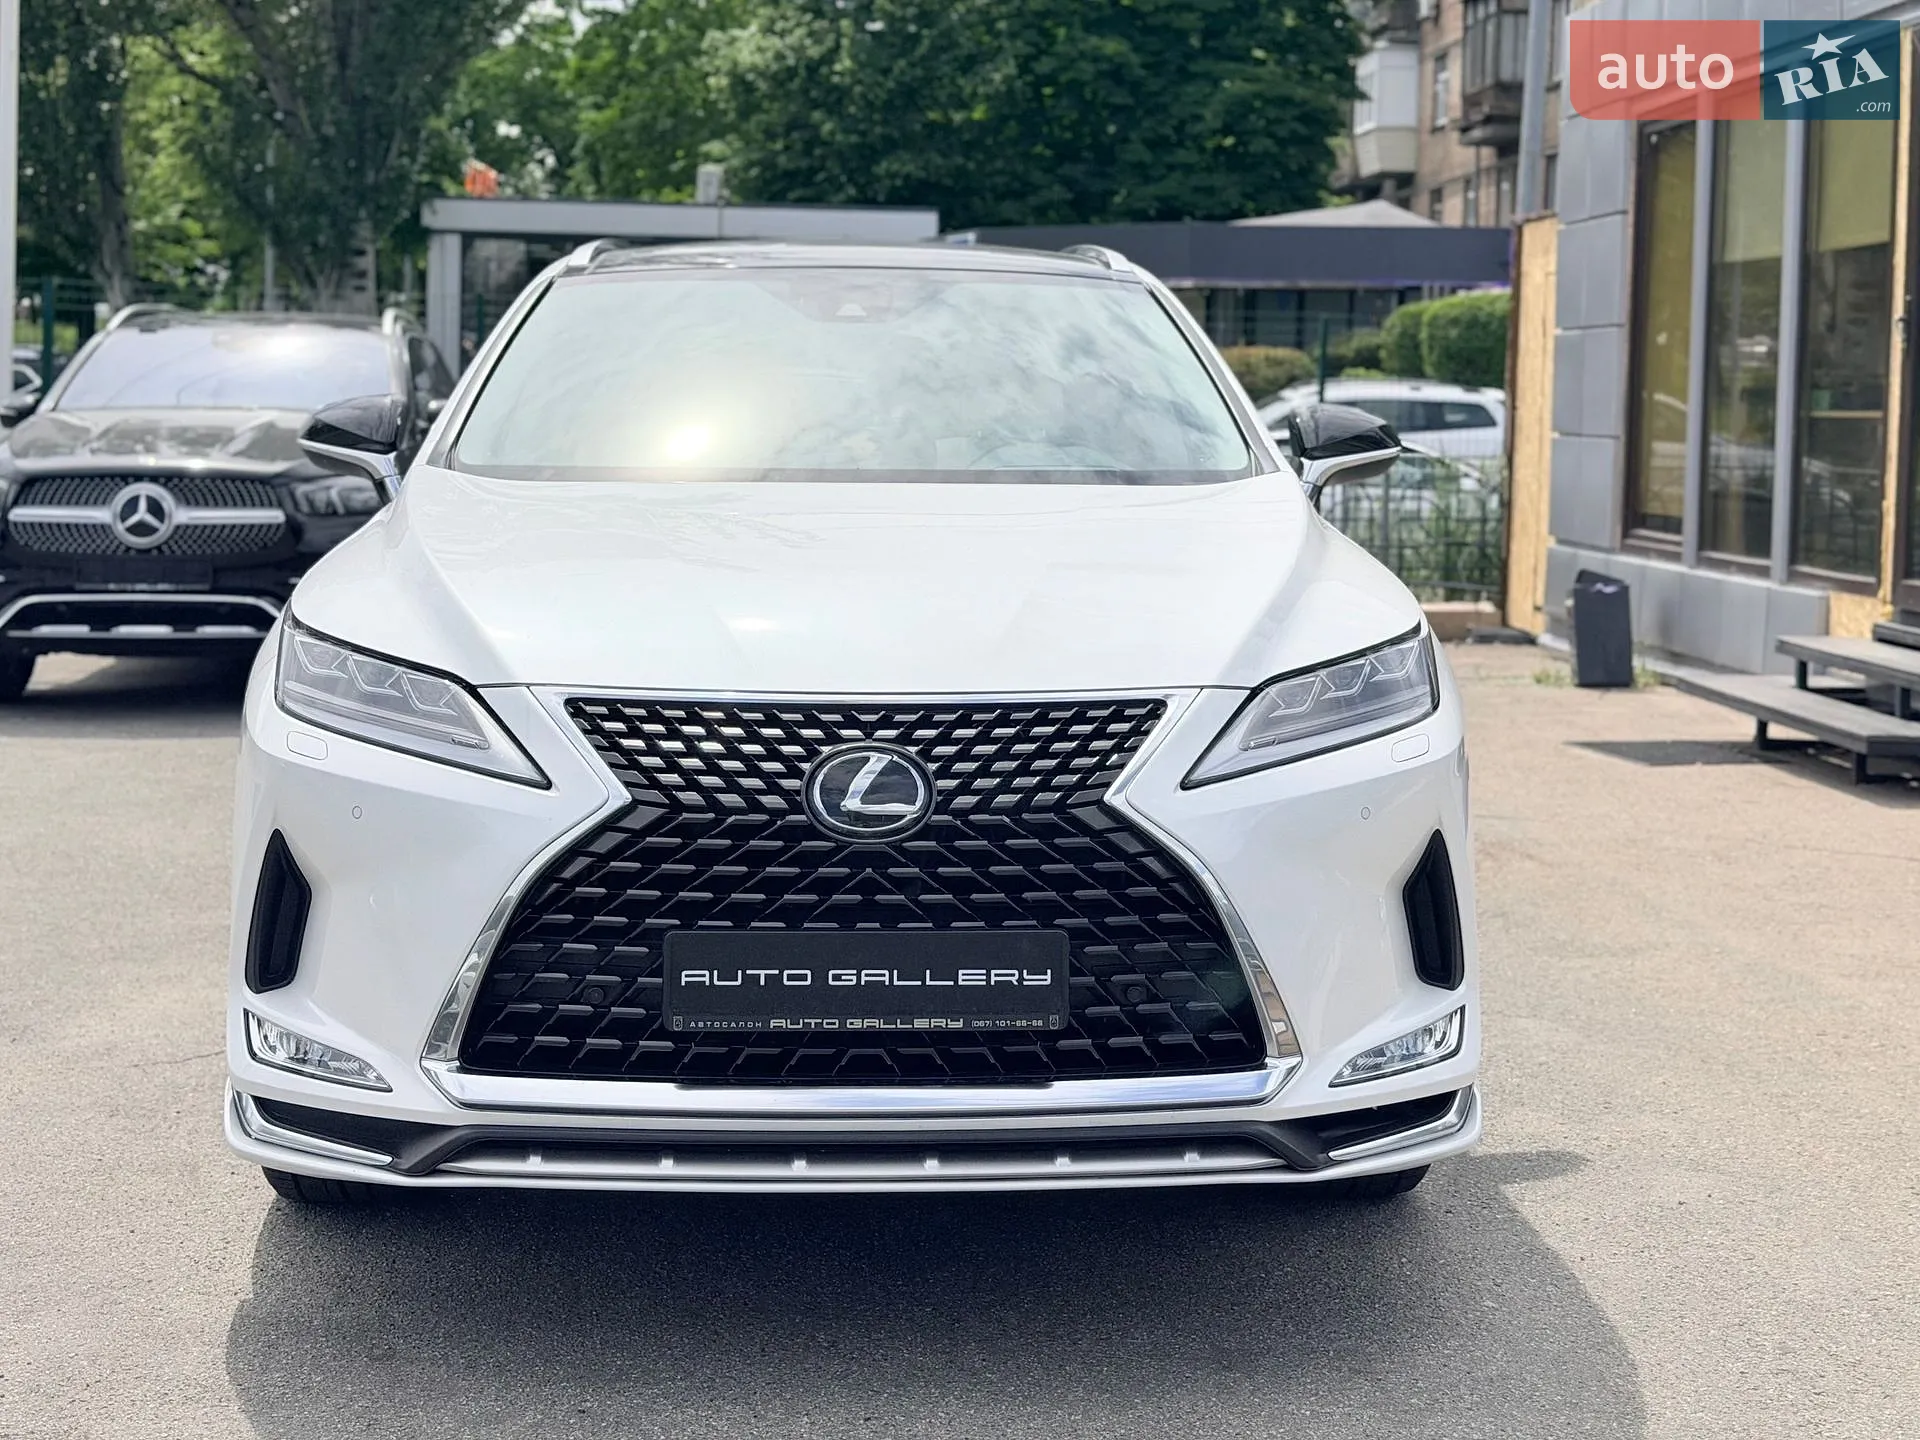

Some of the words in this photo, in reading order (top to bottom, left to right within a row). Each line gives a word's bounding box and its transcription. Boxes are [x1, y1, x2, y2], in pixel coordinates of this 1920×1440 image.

[680, 969, 812, 985] AUTO
[828, 969, 1051, 985] GALLERY
[769, 1018, 838, 1028] AUTO
[846, 1018, 963, 1028] GALLERY
[971, 1020, 993, 1028] (067)
